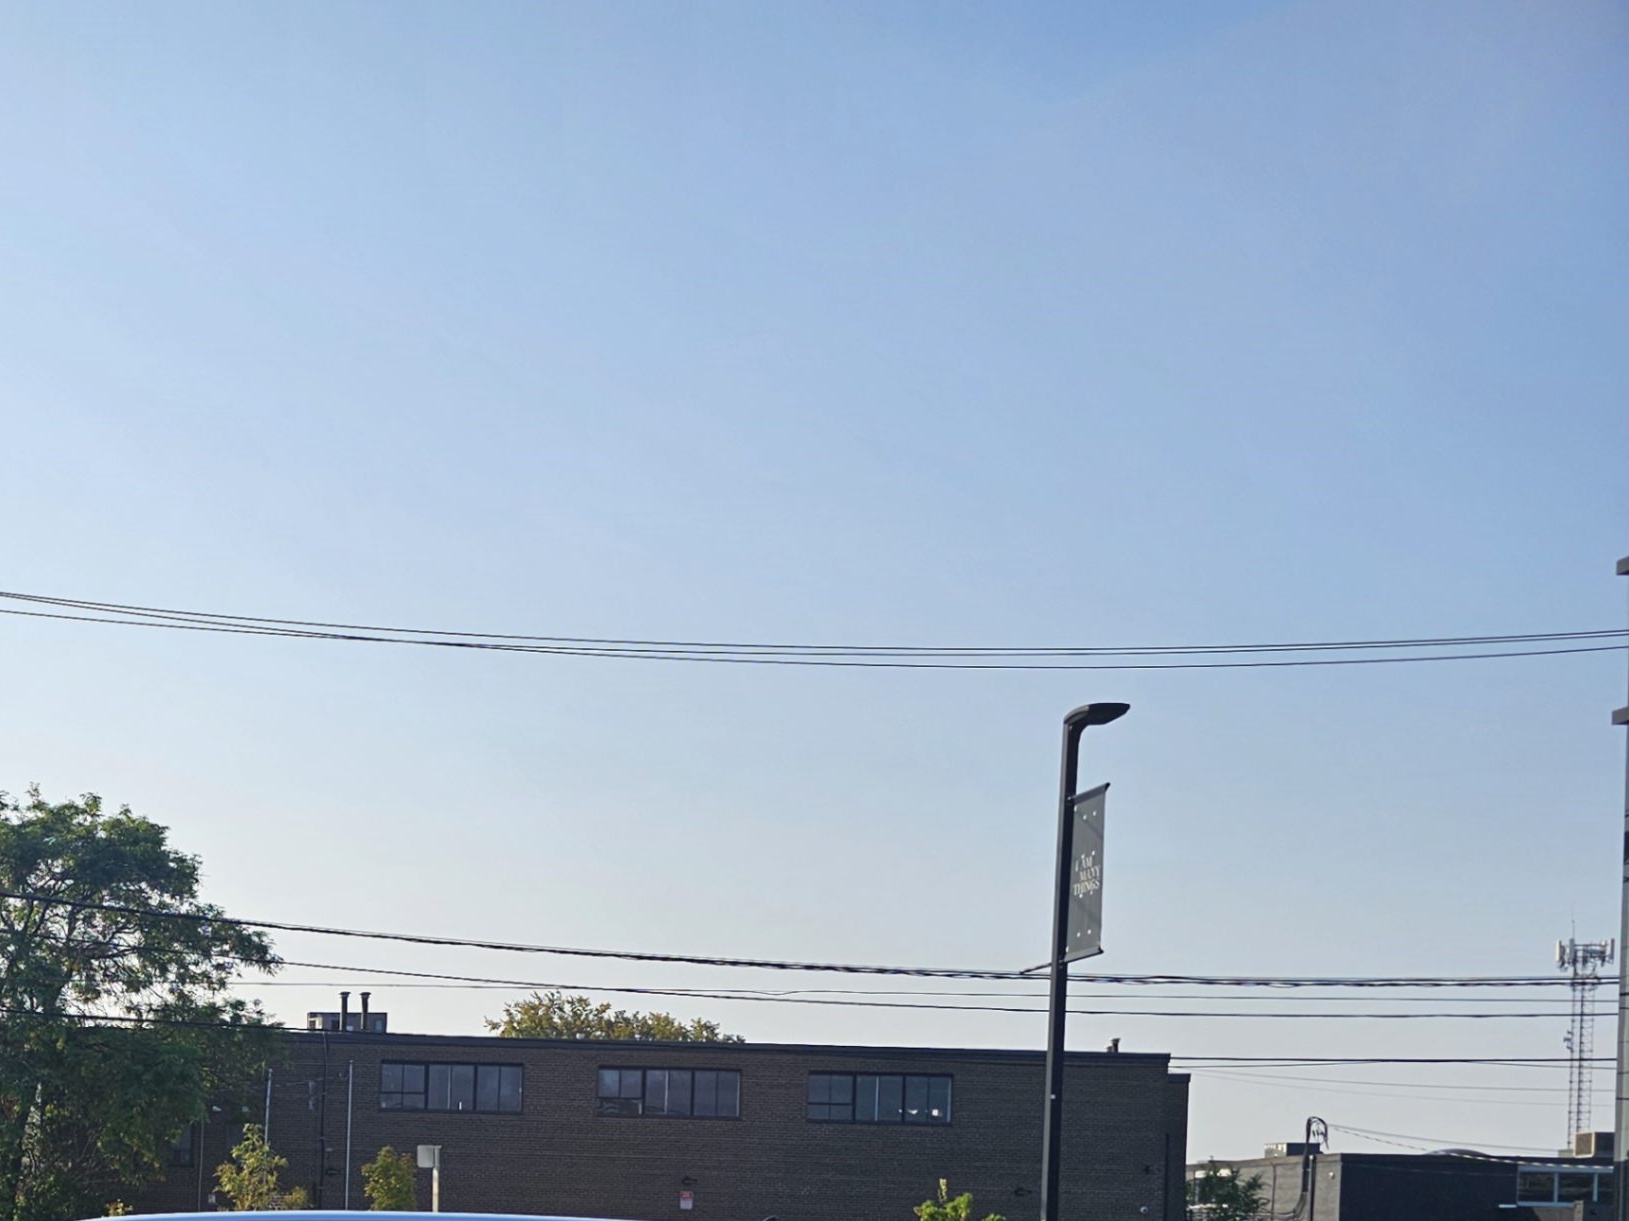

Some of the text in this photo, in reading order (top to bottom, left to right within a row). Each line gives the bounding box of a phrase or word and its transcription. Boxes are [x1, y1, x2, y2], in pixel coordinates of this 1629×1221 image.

[1080, 856, 1093, 869] AM
[1079, 865, 1100, 882] MANY
[1073, 878, 1100, 896] THINGS
